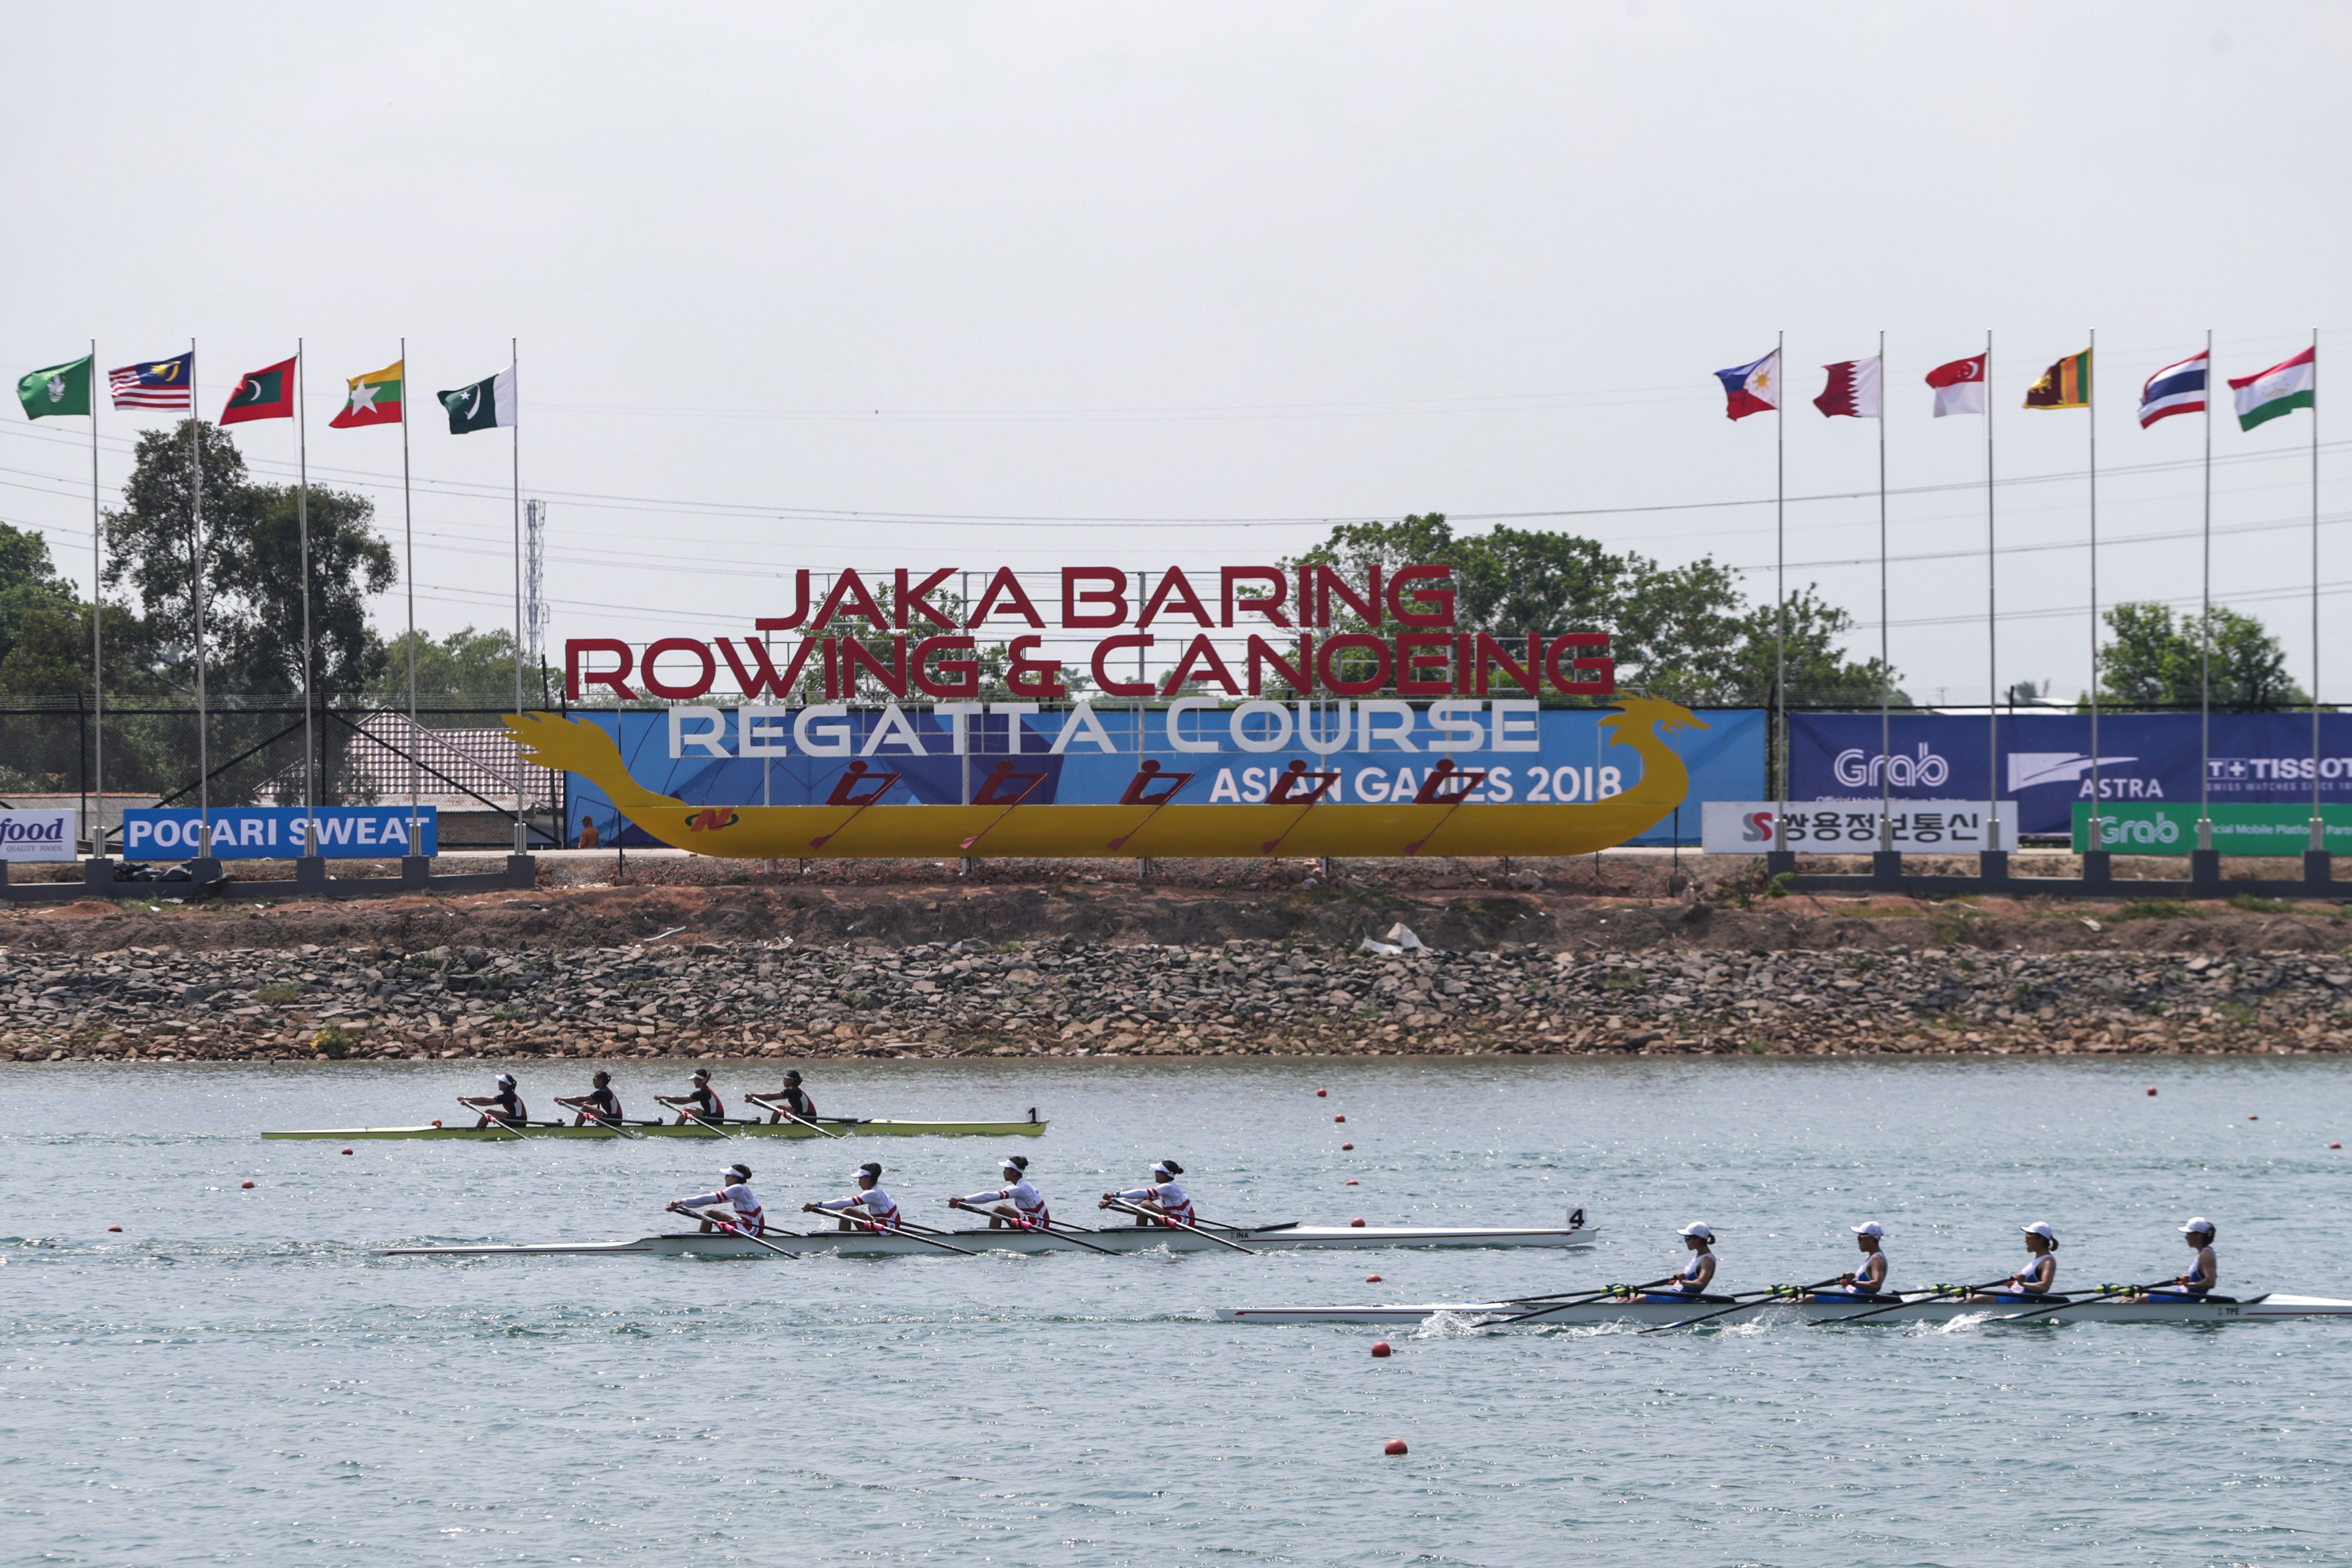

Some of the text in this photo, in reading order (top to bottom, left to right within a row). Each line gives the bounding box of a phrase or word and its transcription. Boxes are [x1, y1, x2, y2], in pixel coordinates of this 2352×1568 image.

[756, 563, 1455, 631] JAKABARING
[566, 632, 1615, 701] ROWING & CANOEING
[669, 697, 1539, 758] REGATTA COURSE
[1834, 742, 1949, 787] Grab
[1209, 767, 1342, 803] ASIAN
[1526, 766, 1622, 801] 2018
[2079, 778, 2164, 798] ASTRA
[2245, 782, 2296, 791] WATCHES
[2301, 781, 2334, 790] SICE
[129, 818, 277, 847] POCARI
[2100, 811, 2180, 844] Grab
[2236, 824, 2273, 835] Mobile
[6, 845, 35, 853] QUALITY
[1028, 1107, 1036, 1122] 1
[1569, 1208, 1585, 1229] 4
